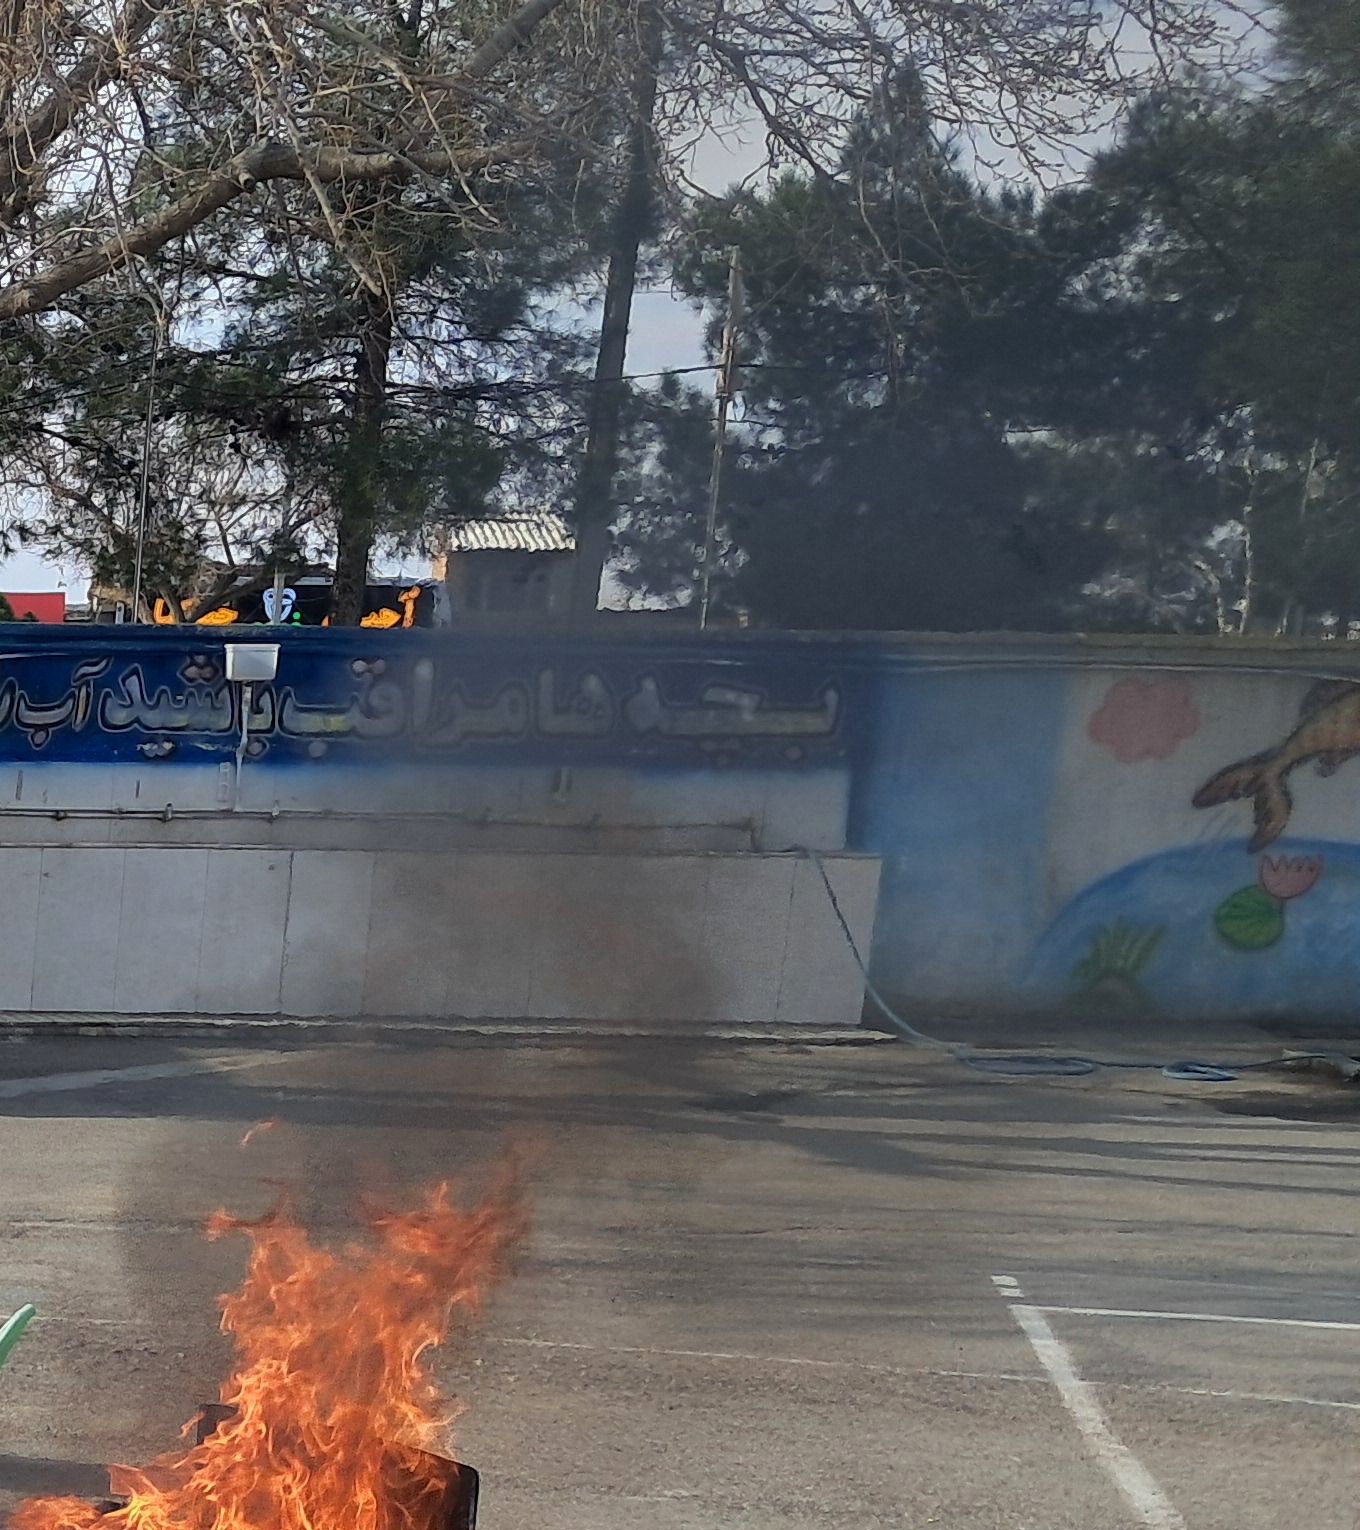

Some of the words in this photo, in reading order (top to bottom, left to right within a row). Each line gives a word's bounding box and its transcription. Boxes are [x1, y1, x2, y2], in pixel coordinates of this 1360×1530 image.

[15, 655, 113, 750] آب
[280, 658, 532, 758] مراقب
[535, 668, 617, 738] ها
[622, 676, 841, 766] بچه
